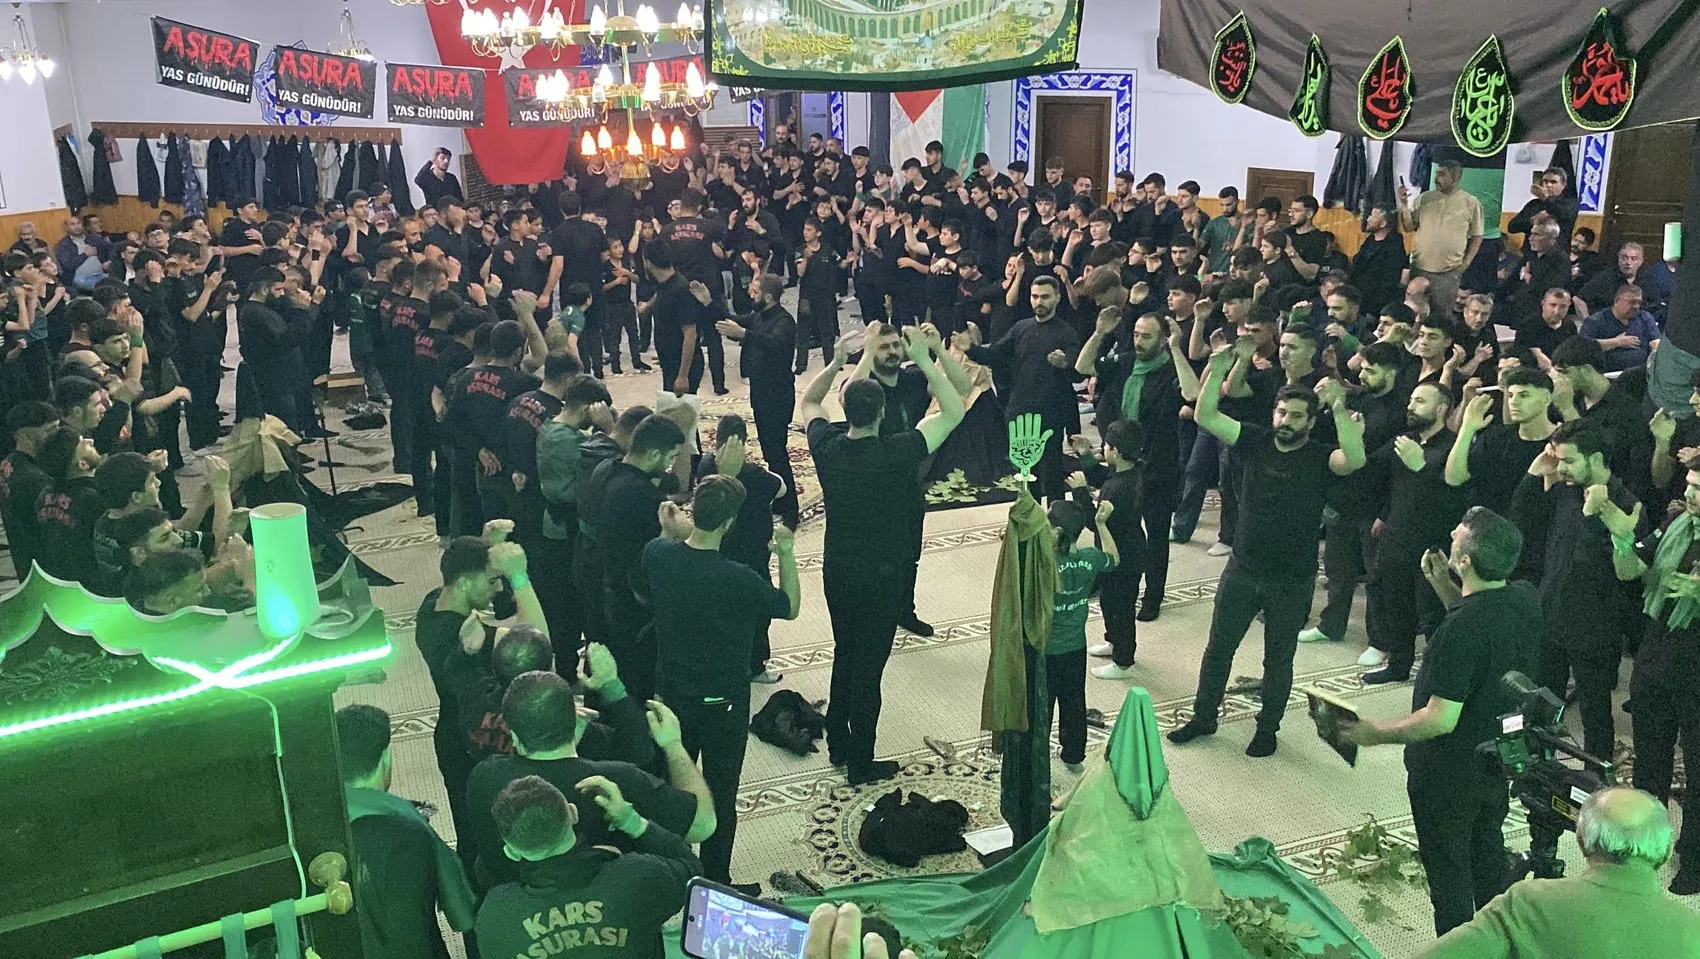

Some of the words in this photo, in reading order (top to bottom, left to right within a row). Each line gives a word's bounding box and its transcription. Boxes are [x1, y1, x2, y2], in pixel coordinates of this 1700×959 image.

[161, 65, 184, 81] YAS
[187, 72, 250, 96] GÜNÜDÜR!
[279, 89, 299, 103] YAS
[302, 93, 362, 114] GÜNÜDÜR!
[393, 104, 415, 117] YAS
[418, 105, 474, 122] GÜNÜDÜR!
[519, 110, 540, 122] YAS
[522, 900, 604, 941] KARS
